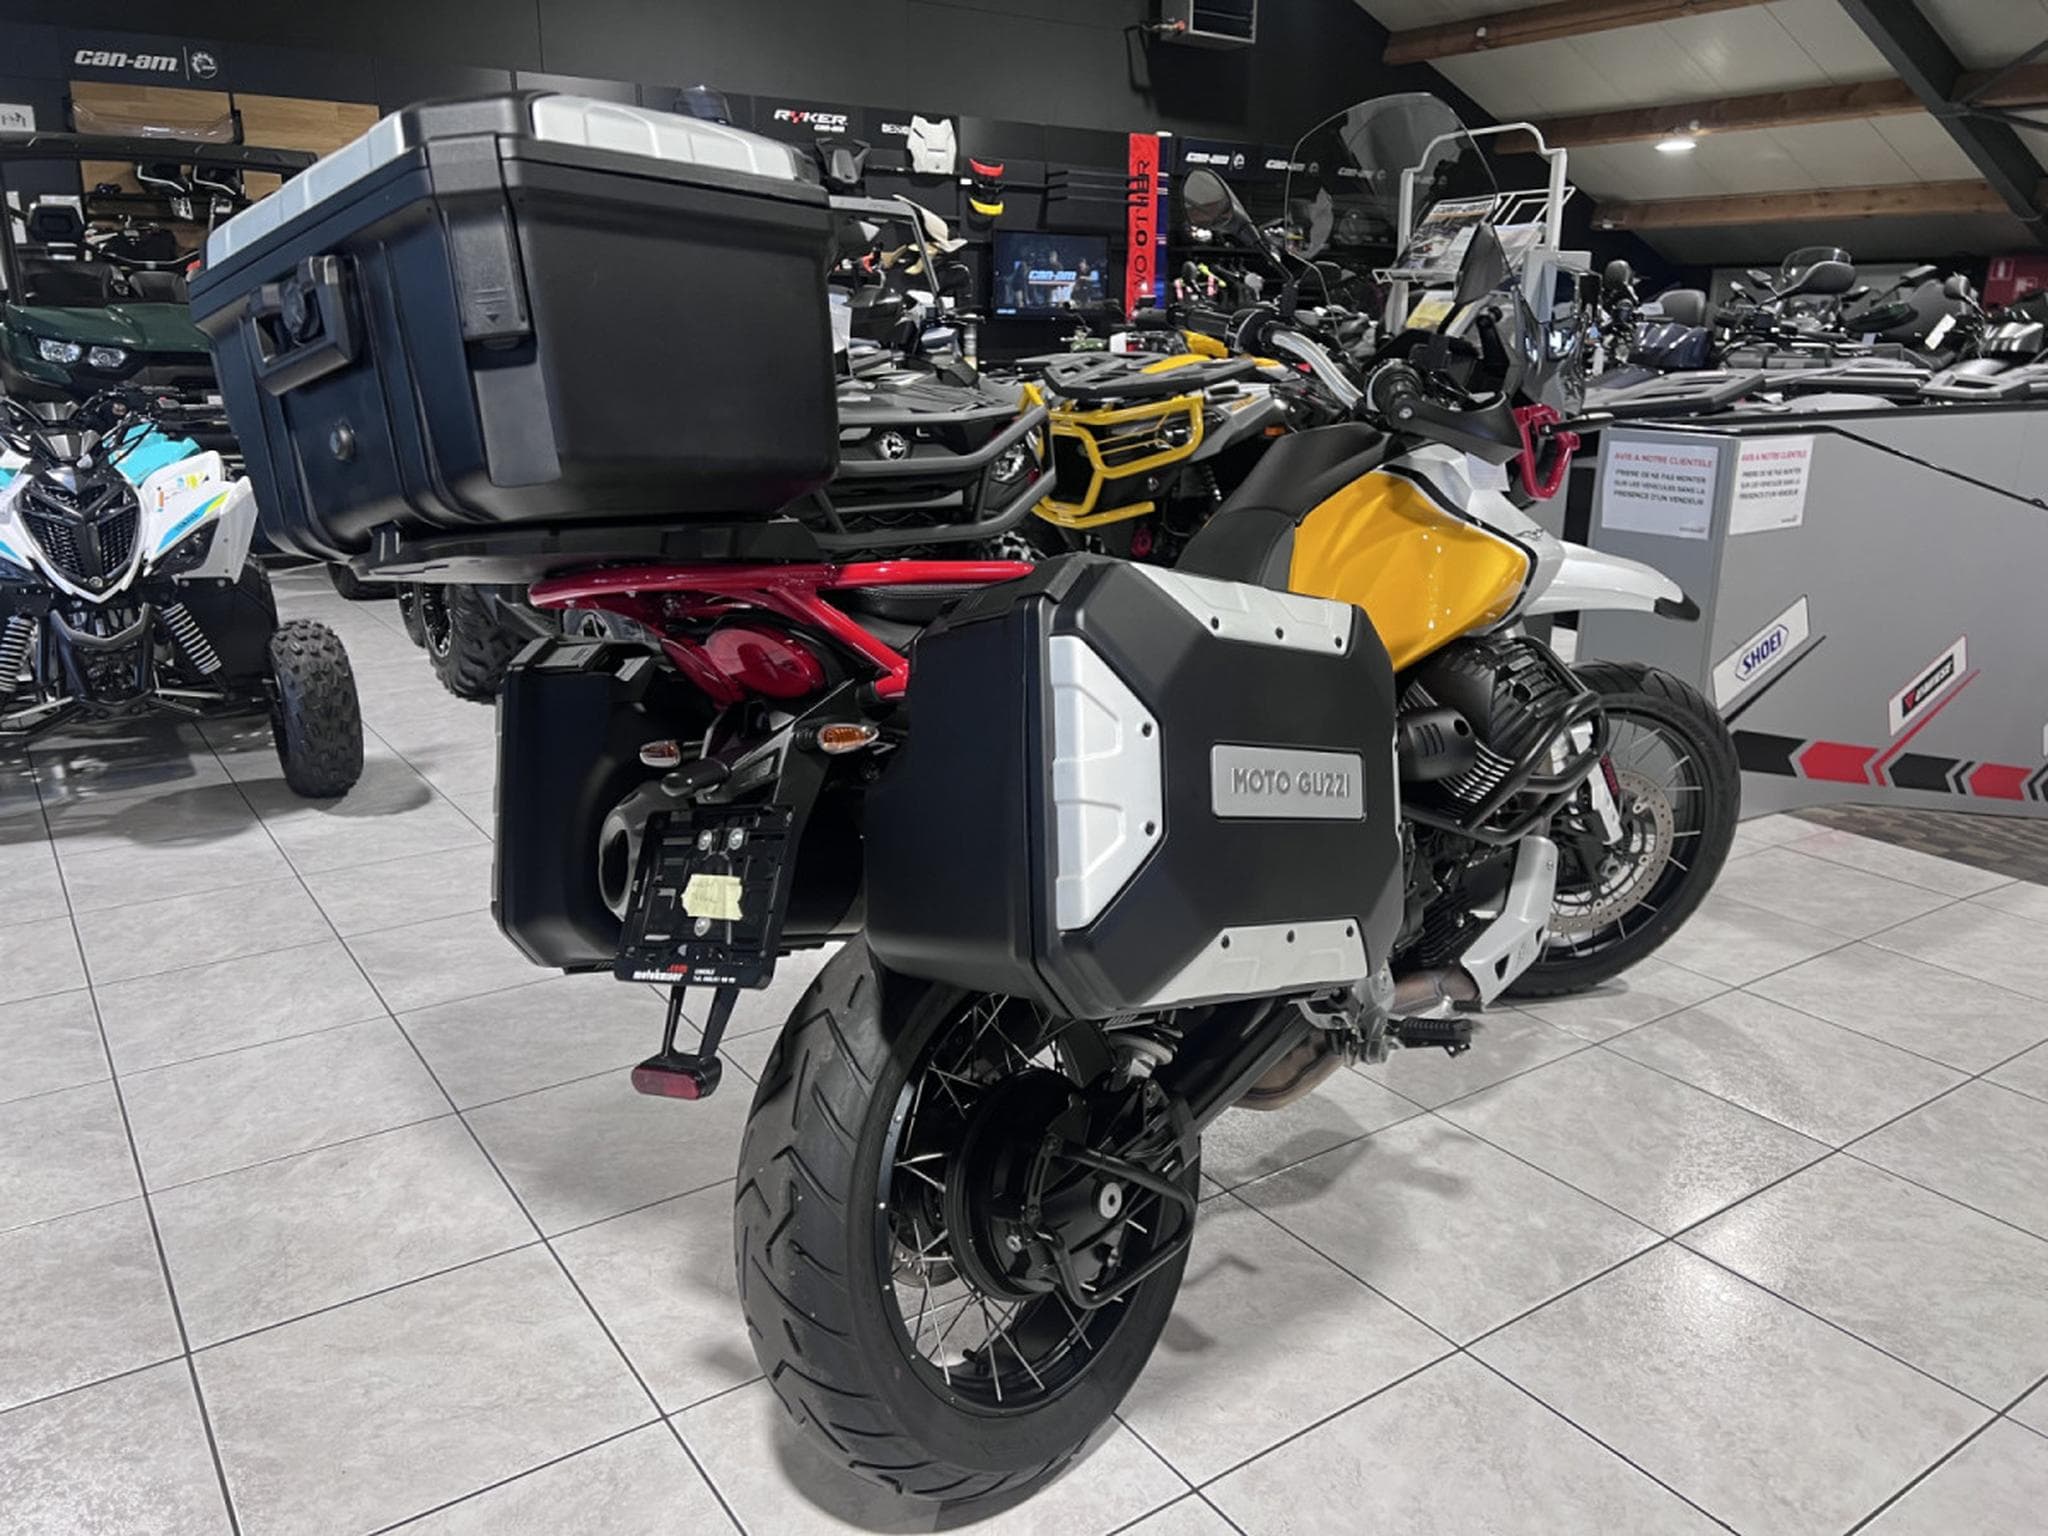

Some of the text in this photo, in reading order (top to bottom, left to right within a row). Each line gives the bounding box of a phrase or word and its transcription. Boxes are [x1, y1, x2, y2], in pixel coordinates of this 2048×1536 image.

[74, 50, 178, 72] can-am
[774, 109, 848, 124] RYKER
[1742, 630, 1782, 675] SHOEI
[1231, 767, 1350, 798] MOTO GUZZI
